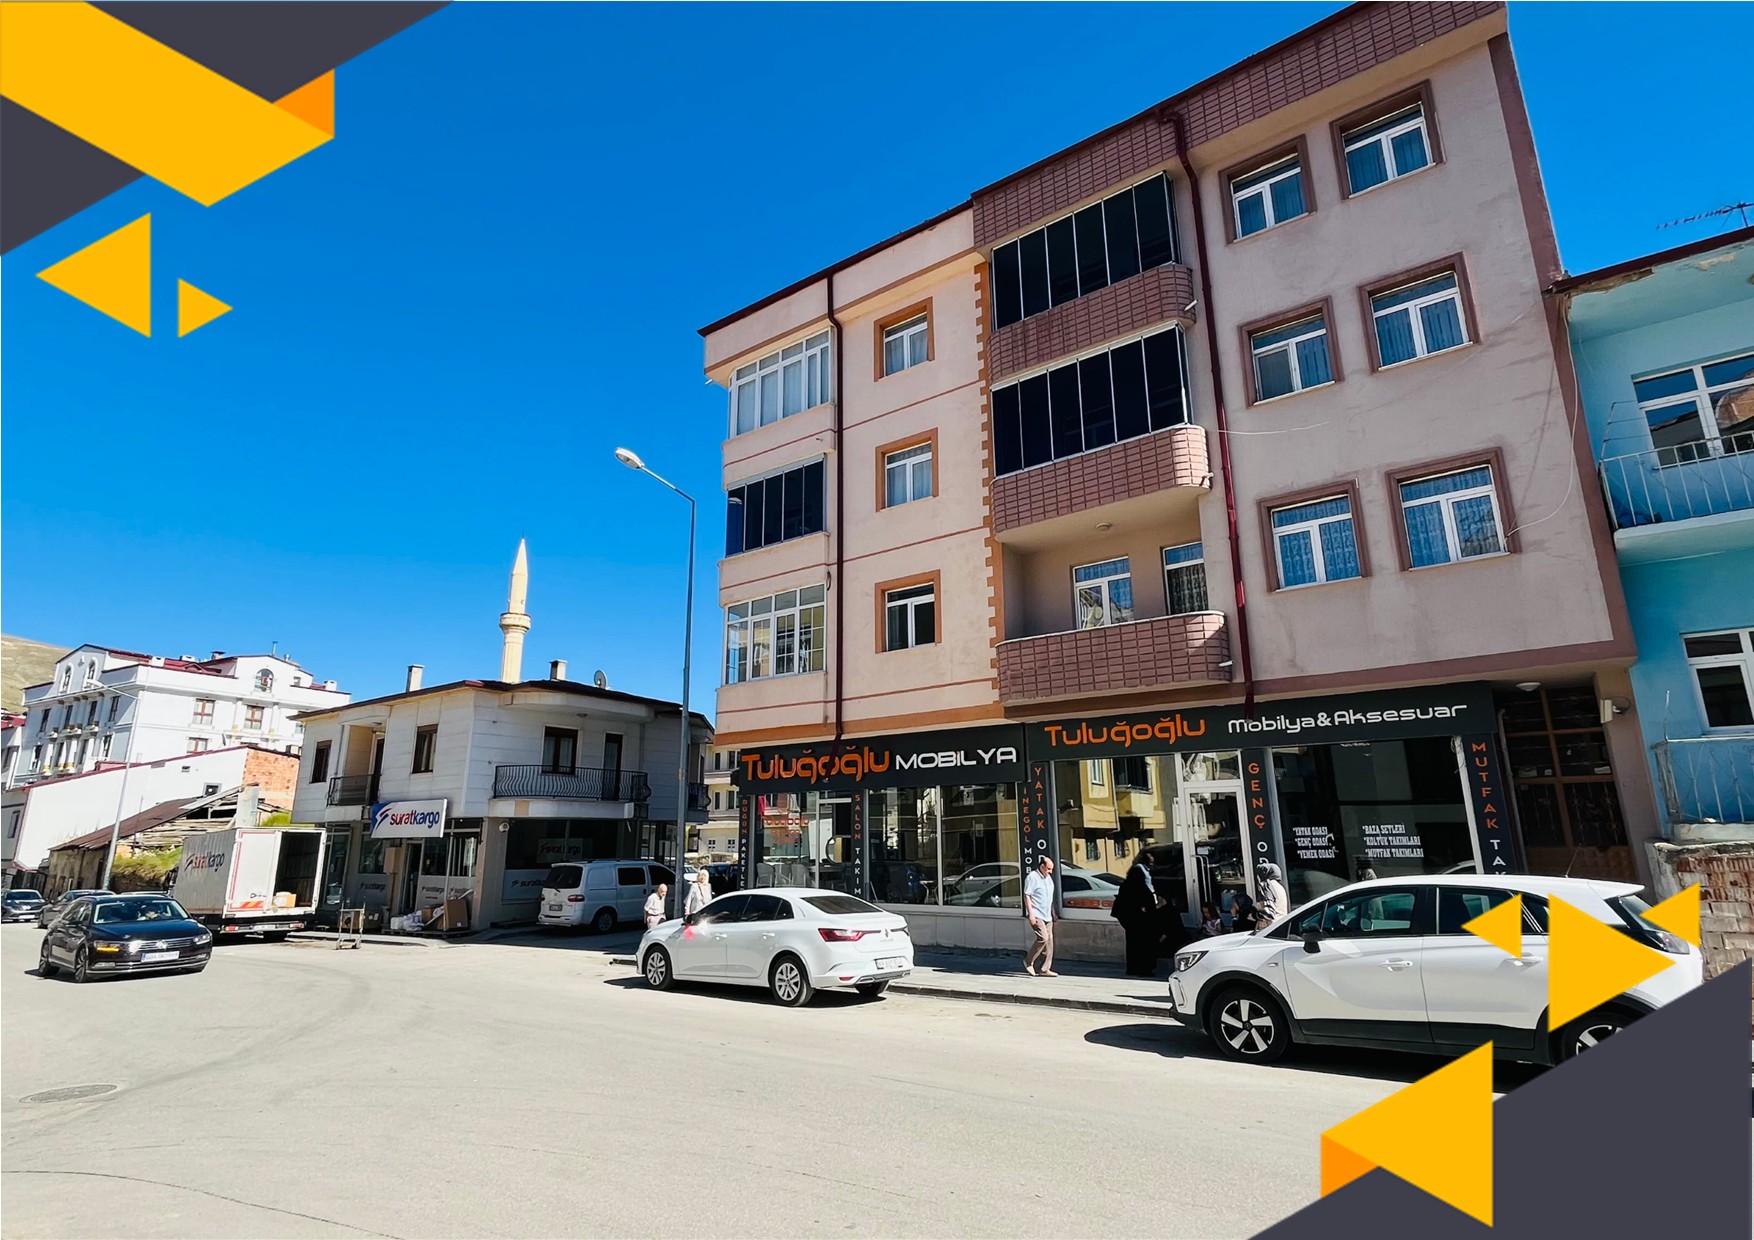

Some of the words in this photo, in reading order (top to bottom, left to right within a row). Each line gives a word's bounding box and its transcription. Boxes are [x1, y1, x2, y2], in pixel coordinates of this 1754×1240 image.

[1044, 713, 1206, 748] Tuluğoğlu
[1228, 704, 1467, 733] Mobilya&Aksesuar
[741, 746, 889, 784] Tuluğoğlu
[1471, 742, 1499, 829] MUTFAK
[854, 794, 862, 840] SALON
[1034, 767, 1045, 829] YATAK
[1248, 762, 1266, 829] GENÇ
[390, 810, 440, 829] suratkargo
[854, 847, 862, 895] TAKIM
